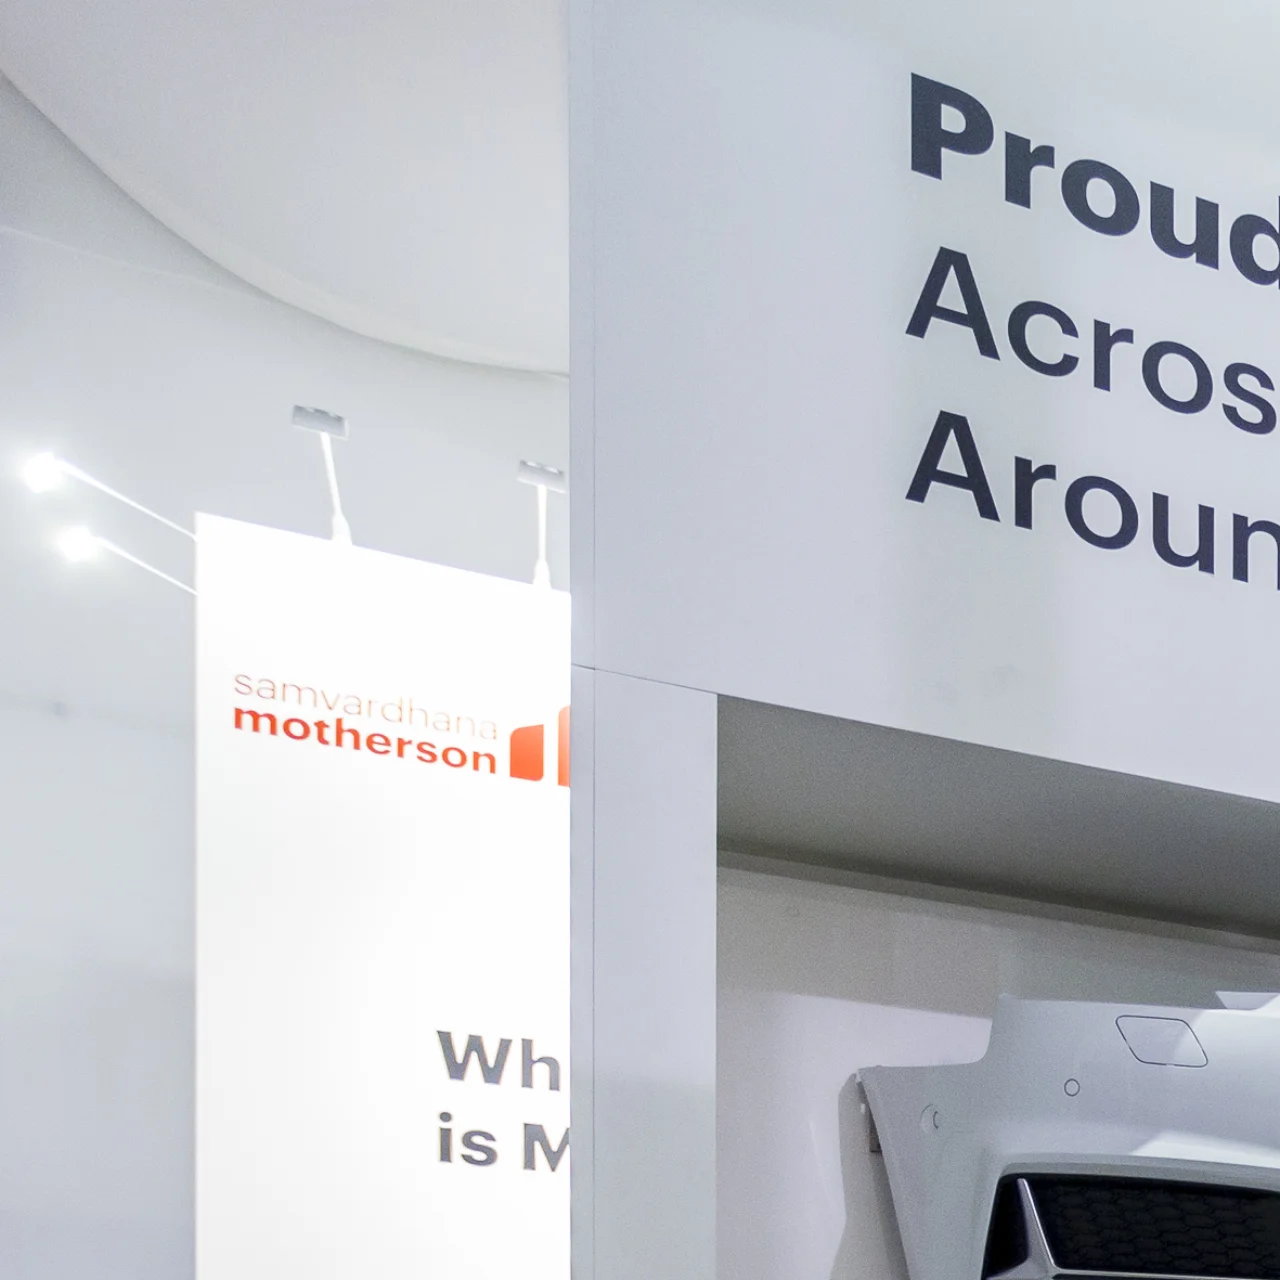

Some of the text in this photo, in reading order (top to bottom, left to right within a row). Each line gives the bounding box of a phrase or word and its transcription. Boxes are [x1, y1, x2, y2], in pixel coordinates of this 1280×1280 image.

[234, 673, 499, 740] samvardhana
[234, 707, 497, 775] motherson
[436, 1030, 561, 1092] Wh
[438, 1111, 498, 1167] is
